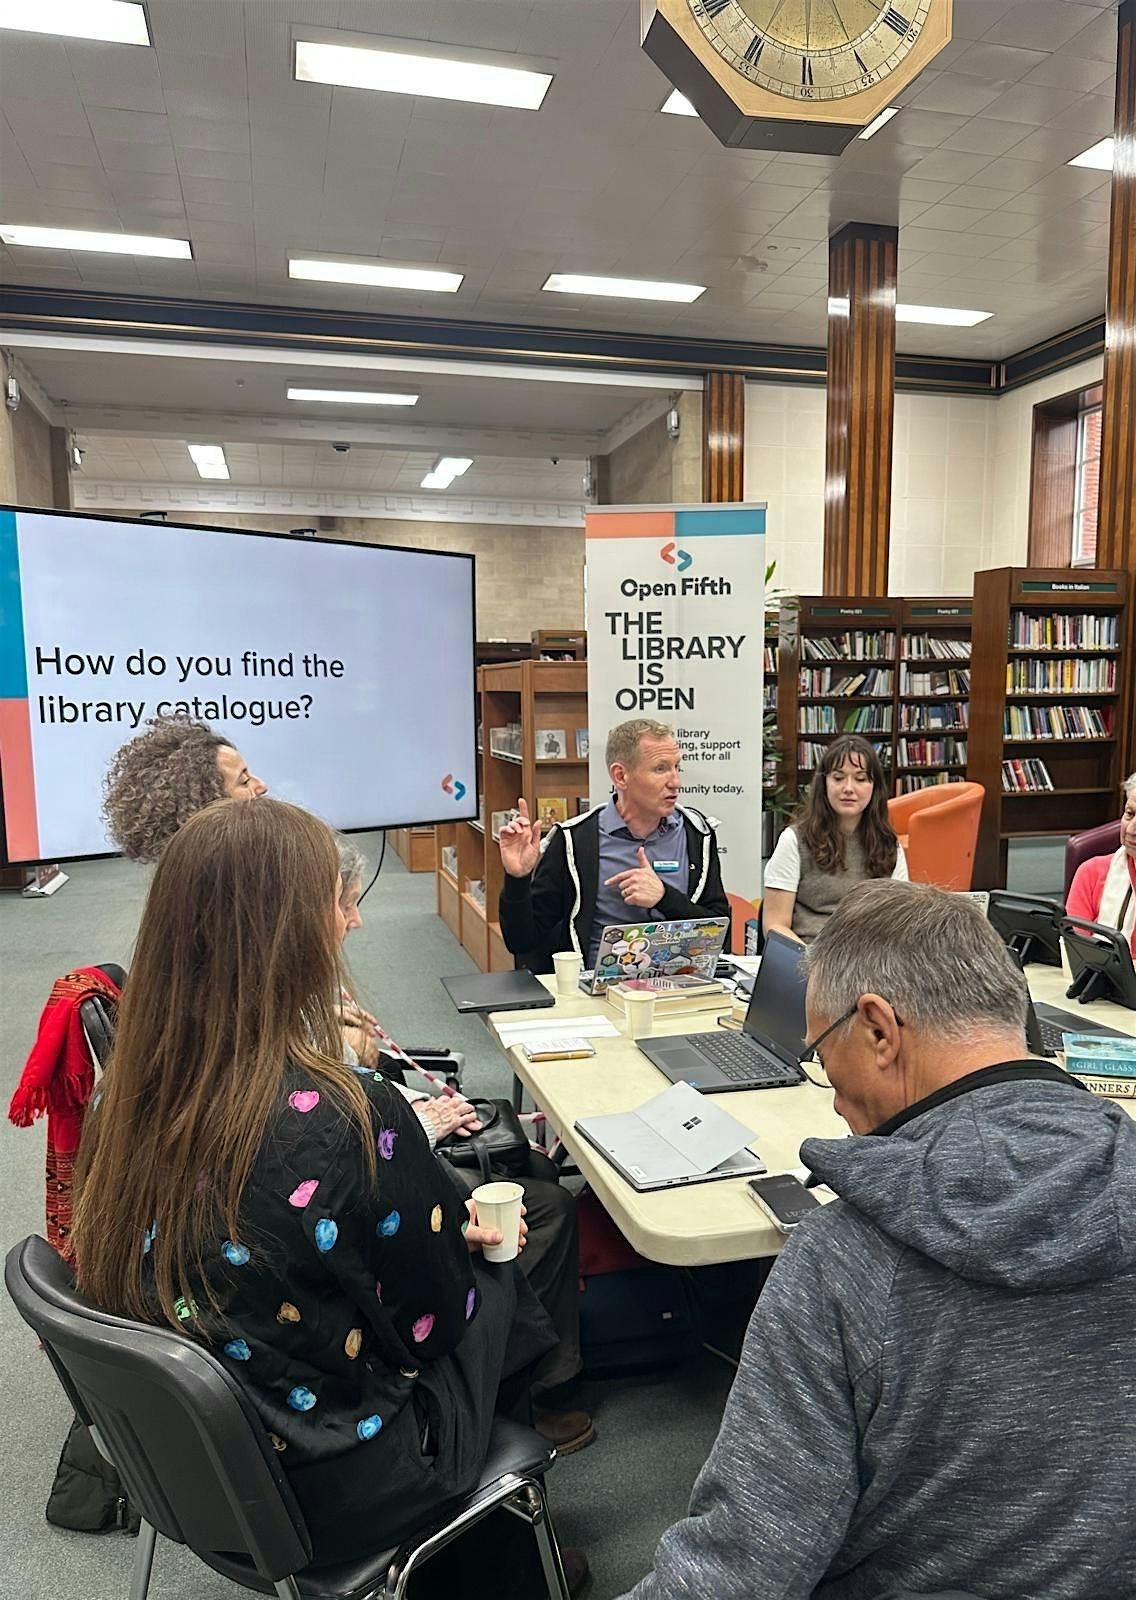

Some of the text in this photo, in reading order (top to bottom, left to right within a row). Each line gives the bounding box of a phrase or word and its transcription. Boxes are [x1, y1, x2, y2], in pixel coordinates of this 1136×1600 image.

[800, 88, 814, 98] 30
[620, 577, 732, 601] Open Fifth
[1074, 583, 1090, 591] Italian
[605, 611, 663, 635] THE
[622, 635, 746, 661] LIBRARY
[35, 646, 345, 683] How do you find the
[638, 662, 664, 686] IS
[615, 687, 695, 711] OPEN
[38, 694, 314, 728] library catalogue?
[677, 729, 711, 740] library
[678, 740, 741, 751] ing, support
[701, 751, 716, 761] for
[718, 751, 731, 761] all
[678, 783, 745, 795] munity today.
[1087, 1083, 1130, 1093] NNERS
